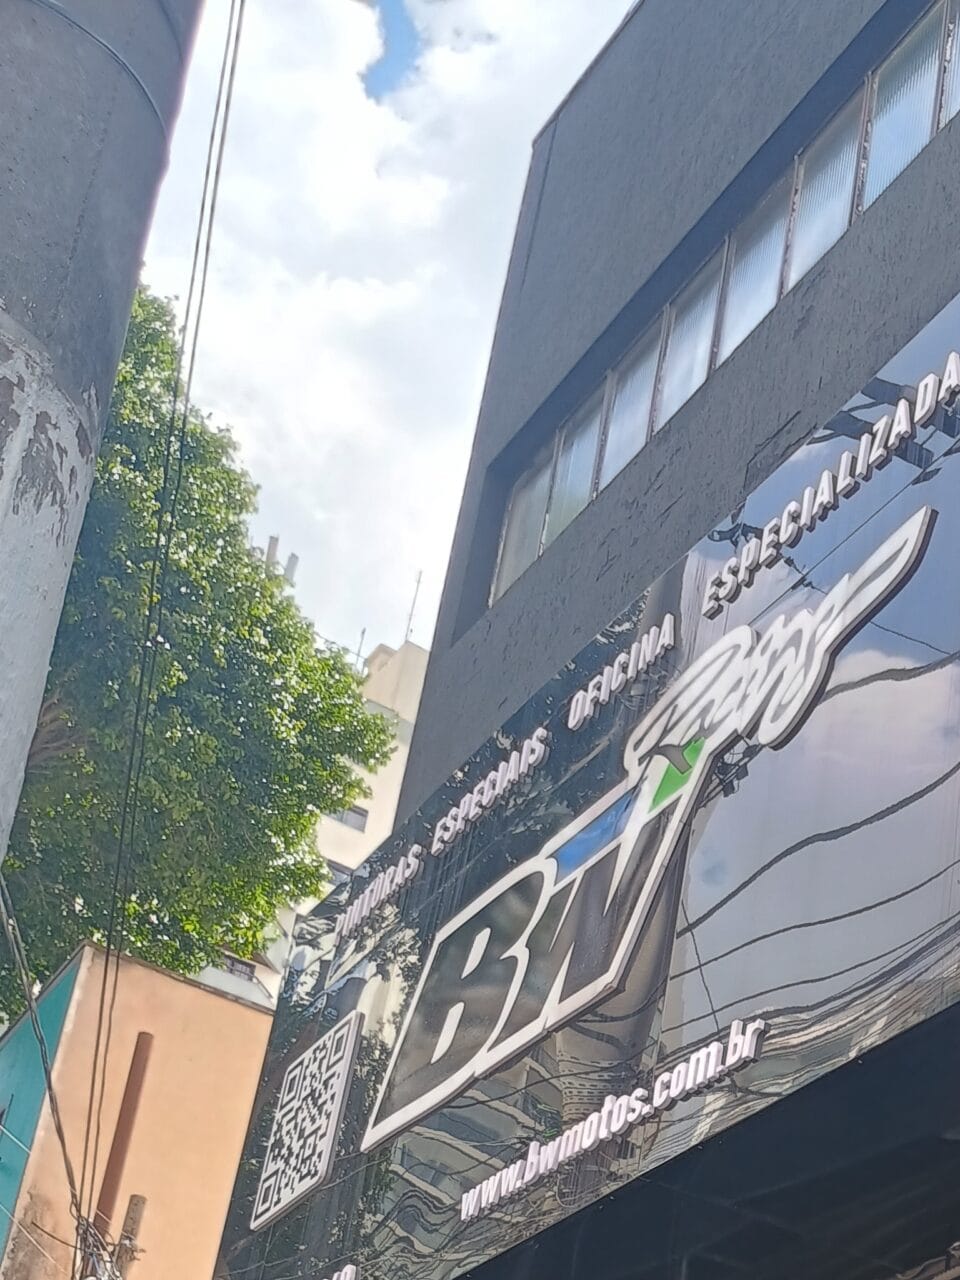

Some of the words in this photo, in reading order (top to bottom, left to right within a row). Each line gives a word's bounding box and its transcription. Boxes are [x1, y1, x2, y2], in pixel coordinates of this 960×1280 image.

[431, 726, 549, 857] ESPECIAIS
[566, 613, 677, 731] OFICINA
[364, 790, 688, 1144] BW
[461, 1018, 768, 1222] www.bwmotos.com.br
